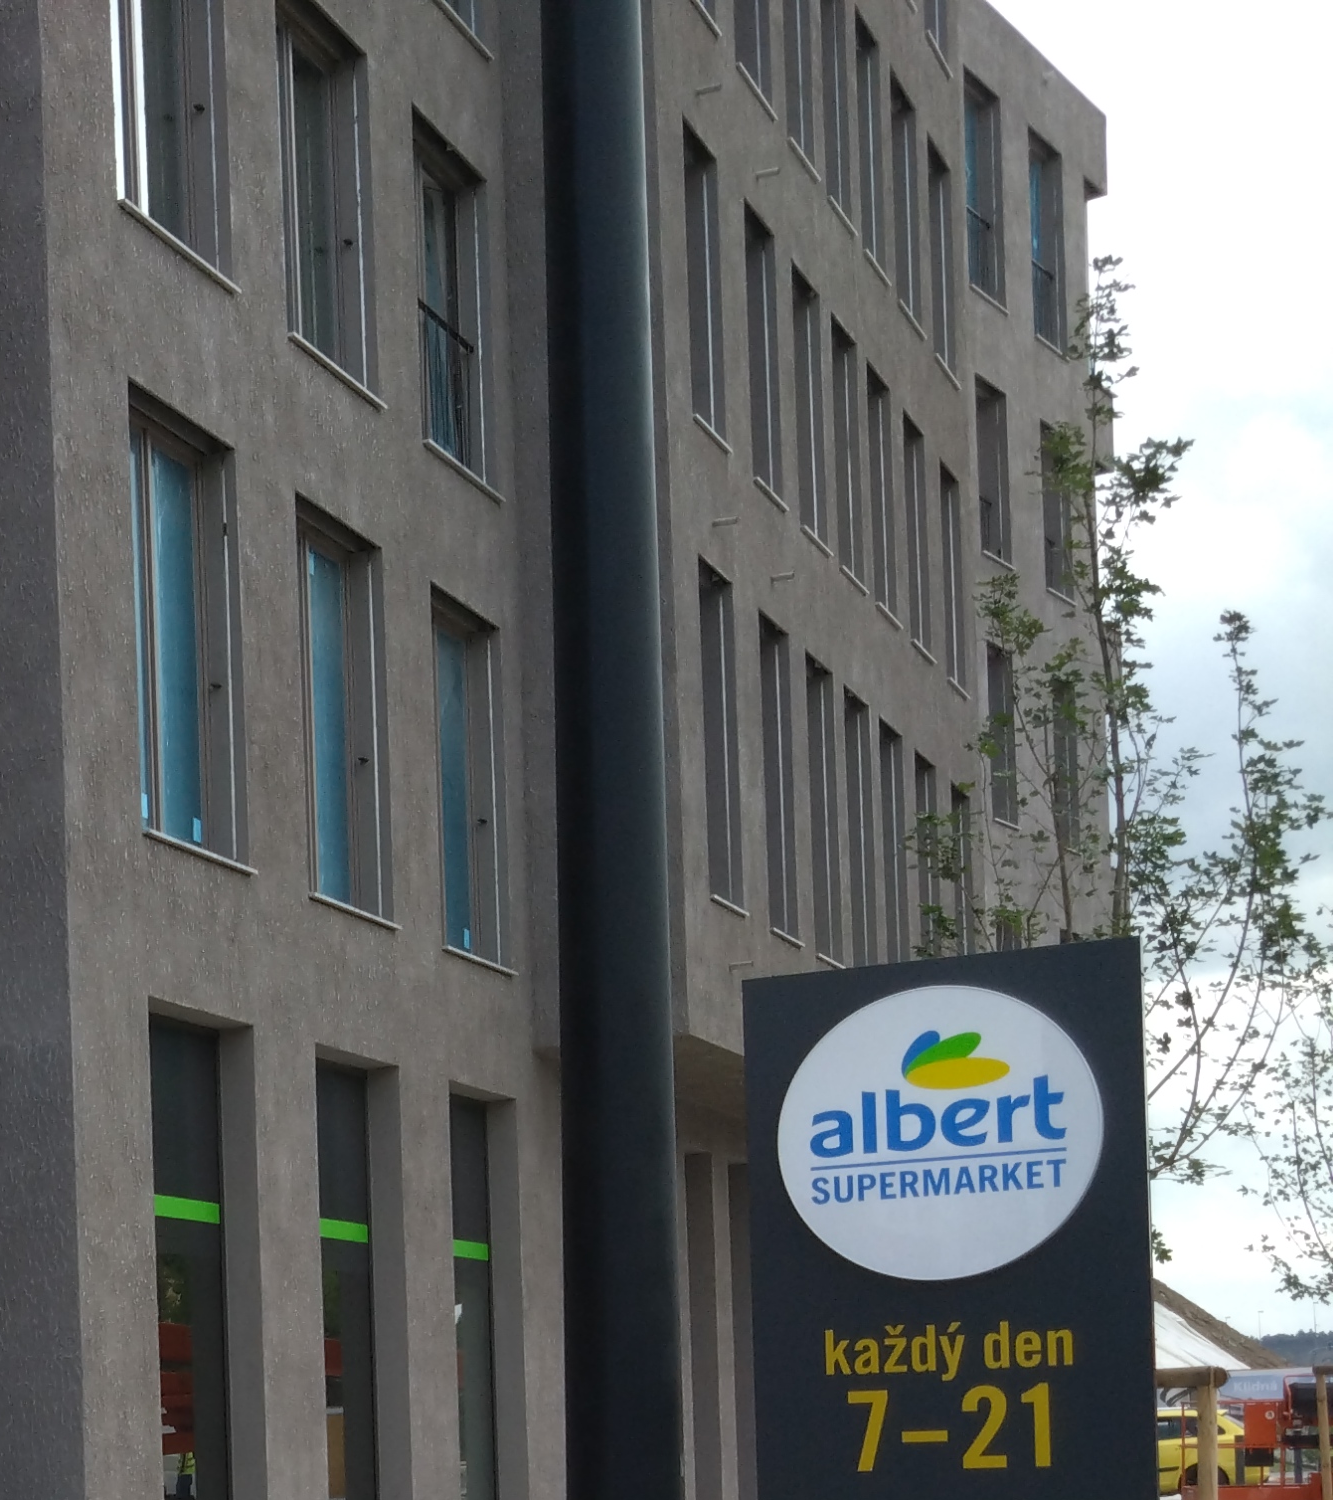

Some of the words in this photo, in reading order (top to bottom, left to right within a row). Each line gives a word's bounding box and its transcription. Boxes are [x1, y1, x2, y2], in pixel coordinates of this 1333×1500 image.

[810, 1074, 1068, 1159] albert
[811, 1158, 1067, 1205] SUPERMARKET
[824, 1321, 966, 1381] každý
[983, 1321, 1074, 1371] den
